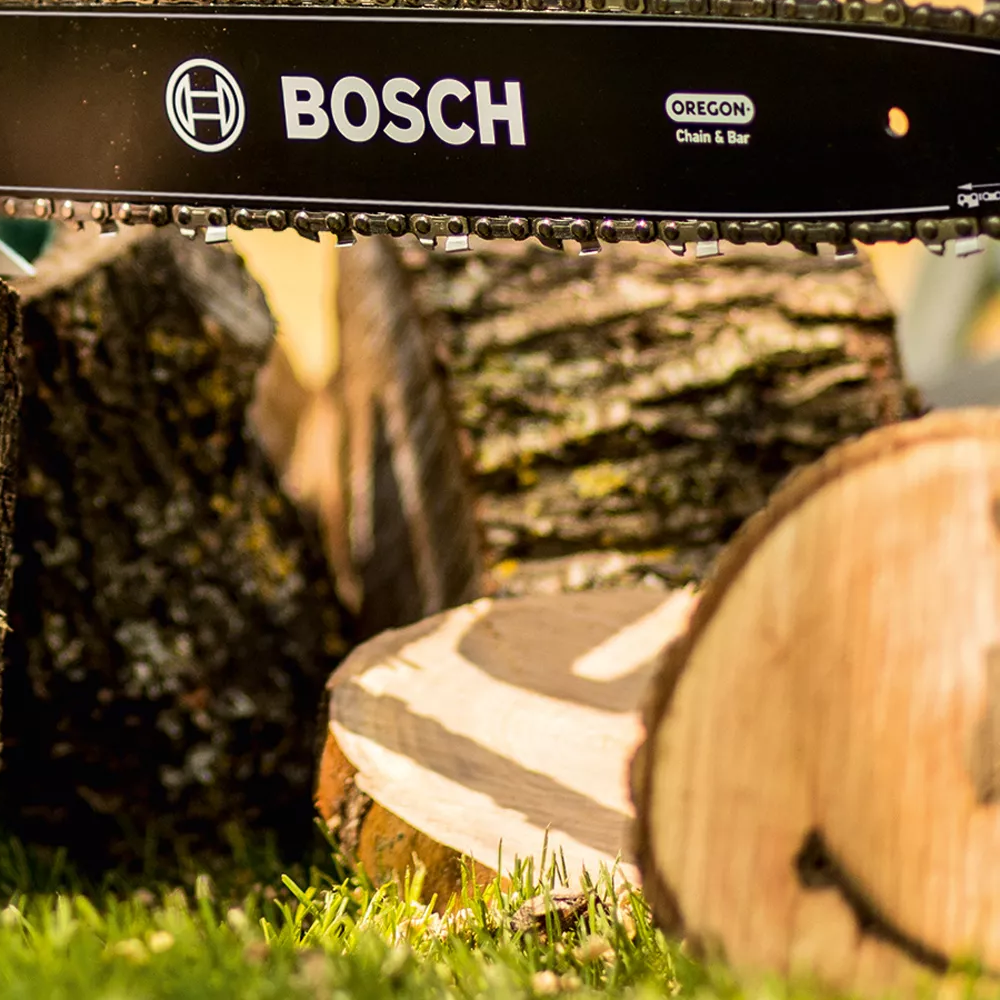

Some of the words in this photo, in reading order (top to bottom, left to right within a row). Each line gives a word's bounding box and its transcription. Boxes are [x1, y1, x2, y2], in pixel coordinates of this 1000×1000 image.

[281, 76, 526, 146] BOSCH
[671, 100, 746, 116] OREGON
[676, 128, 712, 143] Chain
[714, 130, 725, 144] &
[727, 130, 750, 145] Bar
